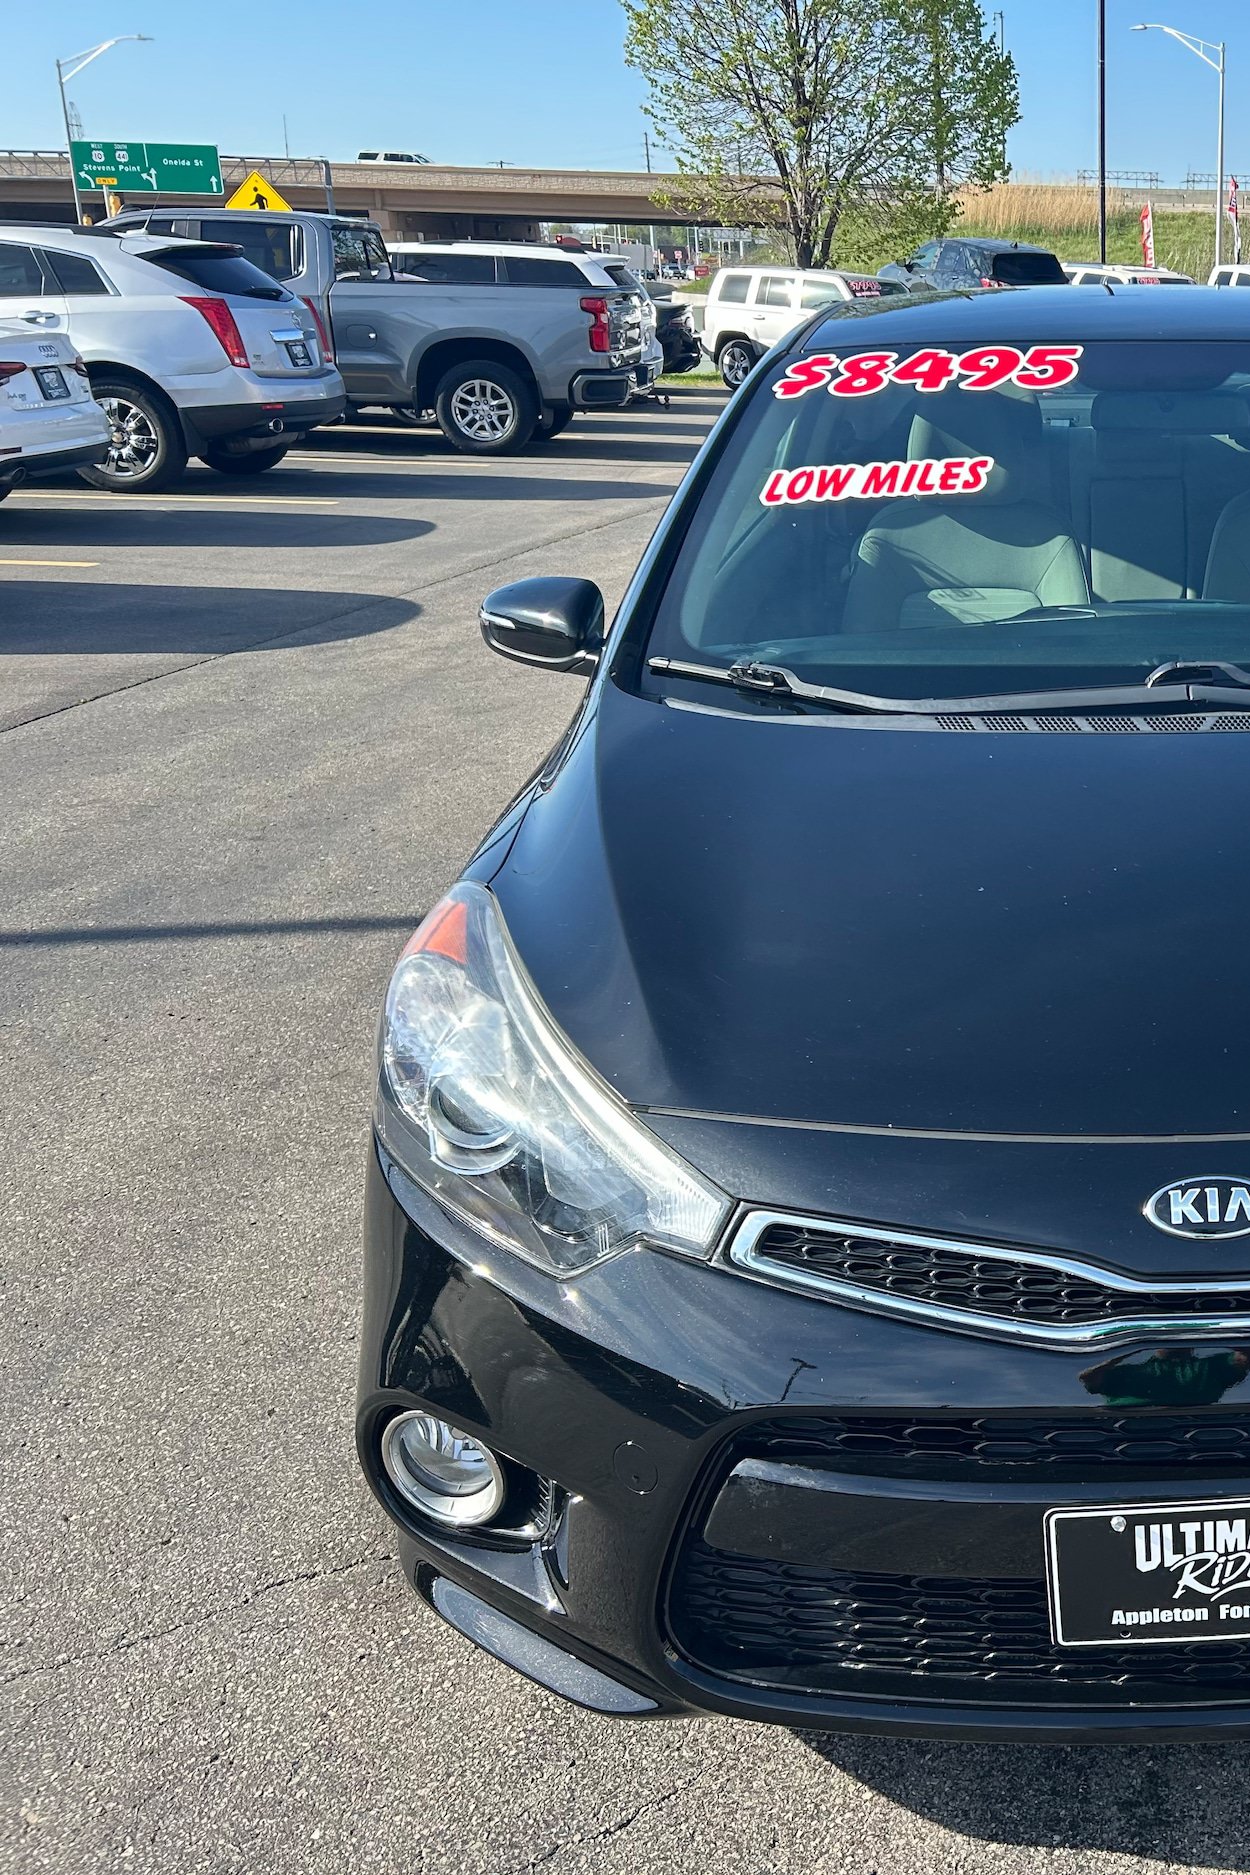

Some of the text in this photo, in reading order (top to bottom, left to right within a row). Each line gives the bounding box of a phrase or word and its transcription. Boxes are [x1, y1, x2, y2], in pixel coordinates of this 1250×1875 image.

[94, 152, 103, 160] 10
[162, 158, 204, 167] Oneida St
[82, 163, 141, 172] Stevens Point
[773, 346, 1083, 398] $8495
[764, 458, 991, 503] LOW MILES
[1111, 1605, 1209, 1627] Appleton
